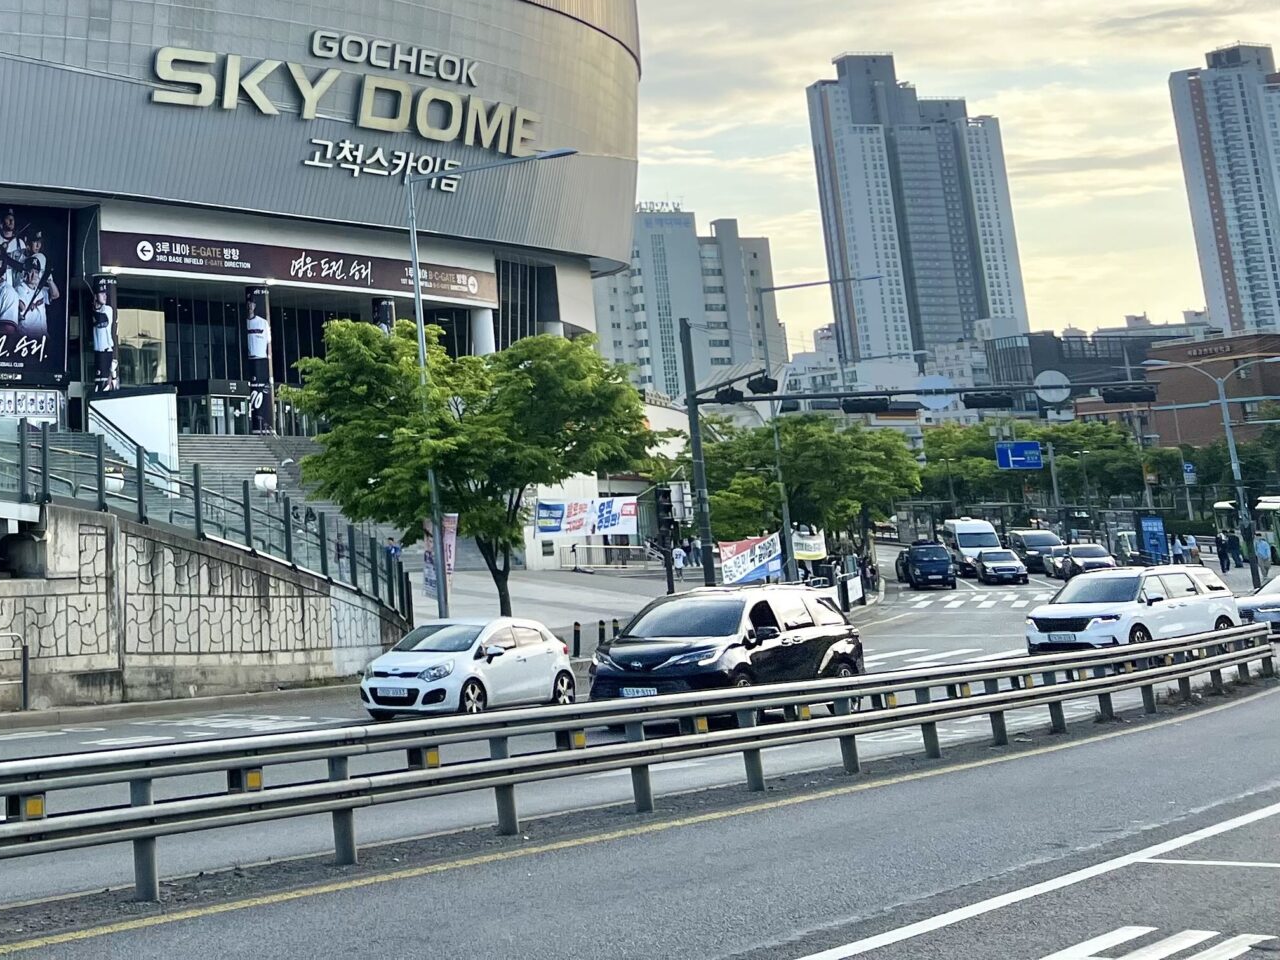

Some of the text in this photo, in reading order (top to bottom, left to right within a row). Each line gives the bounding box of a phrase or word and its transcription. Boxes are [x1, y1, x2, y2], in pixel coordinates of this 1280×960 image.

[311, 29, 479, 88] GOCHEOK
[150, 46, 543, 158] SKY DOME
[304, 139, 463, 193] 고척스카이돔
[155, 241, 240, 261] 3루 내야 E-GATE 방향
[169, 256, 183, 264] BASE
[224, 261, 251, 269] DIRECTION
